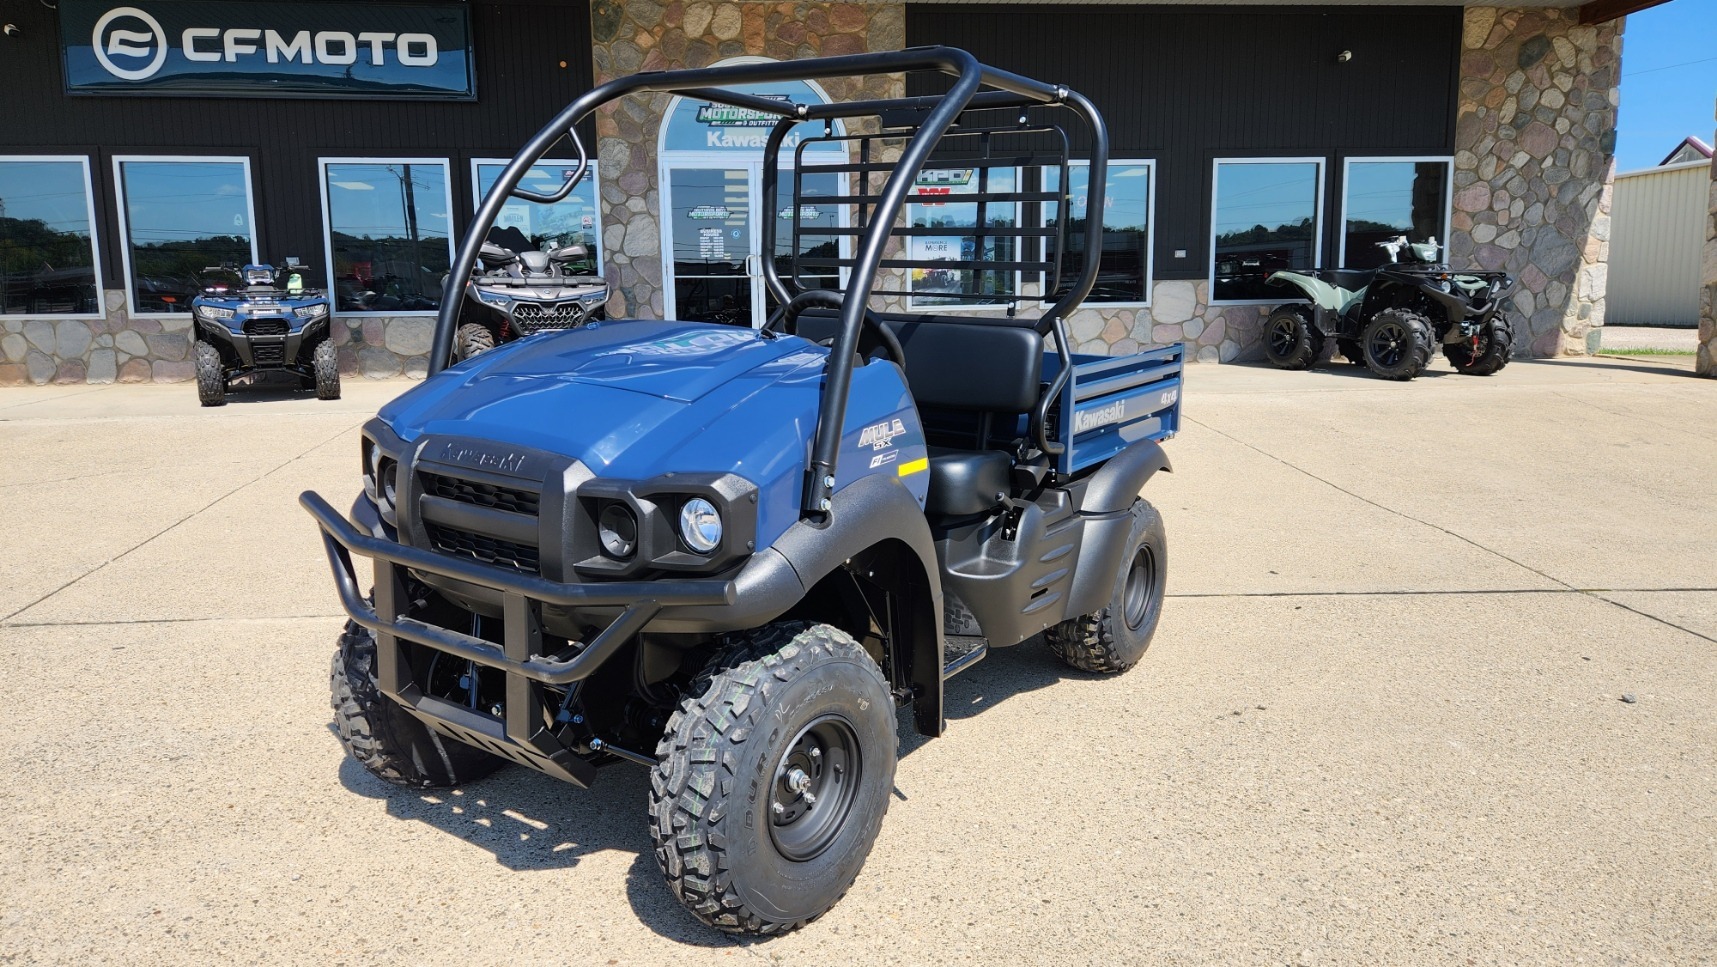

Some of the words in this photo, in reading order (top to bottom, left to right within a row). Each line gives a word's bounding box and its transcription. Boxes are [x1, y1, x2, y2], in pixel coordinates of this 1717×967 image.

[181, 27, 438, 67] CFMOTO
[707, 131, 800, 148] Kawaski
[1077, 196, 1114, 207] ON
[1074, 399, 1125, 432] Kawasaki
[858, 418, 907, 448] MULE
